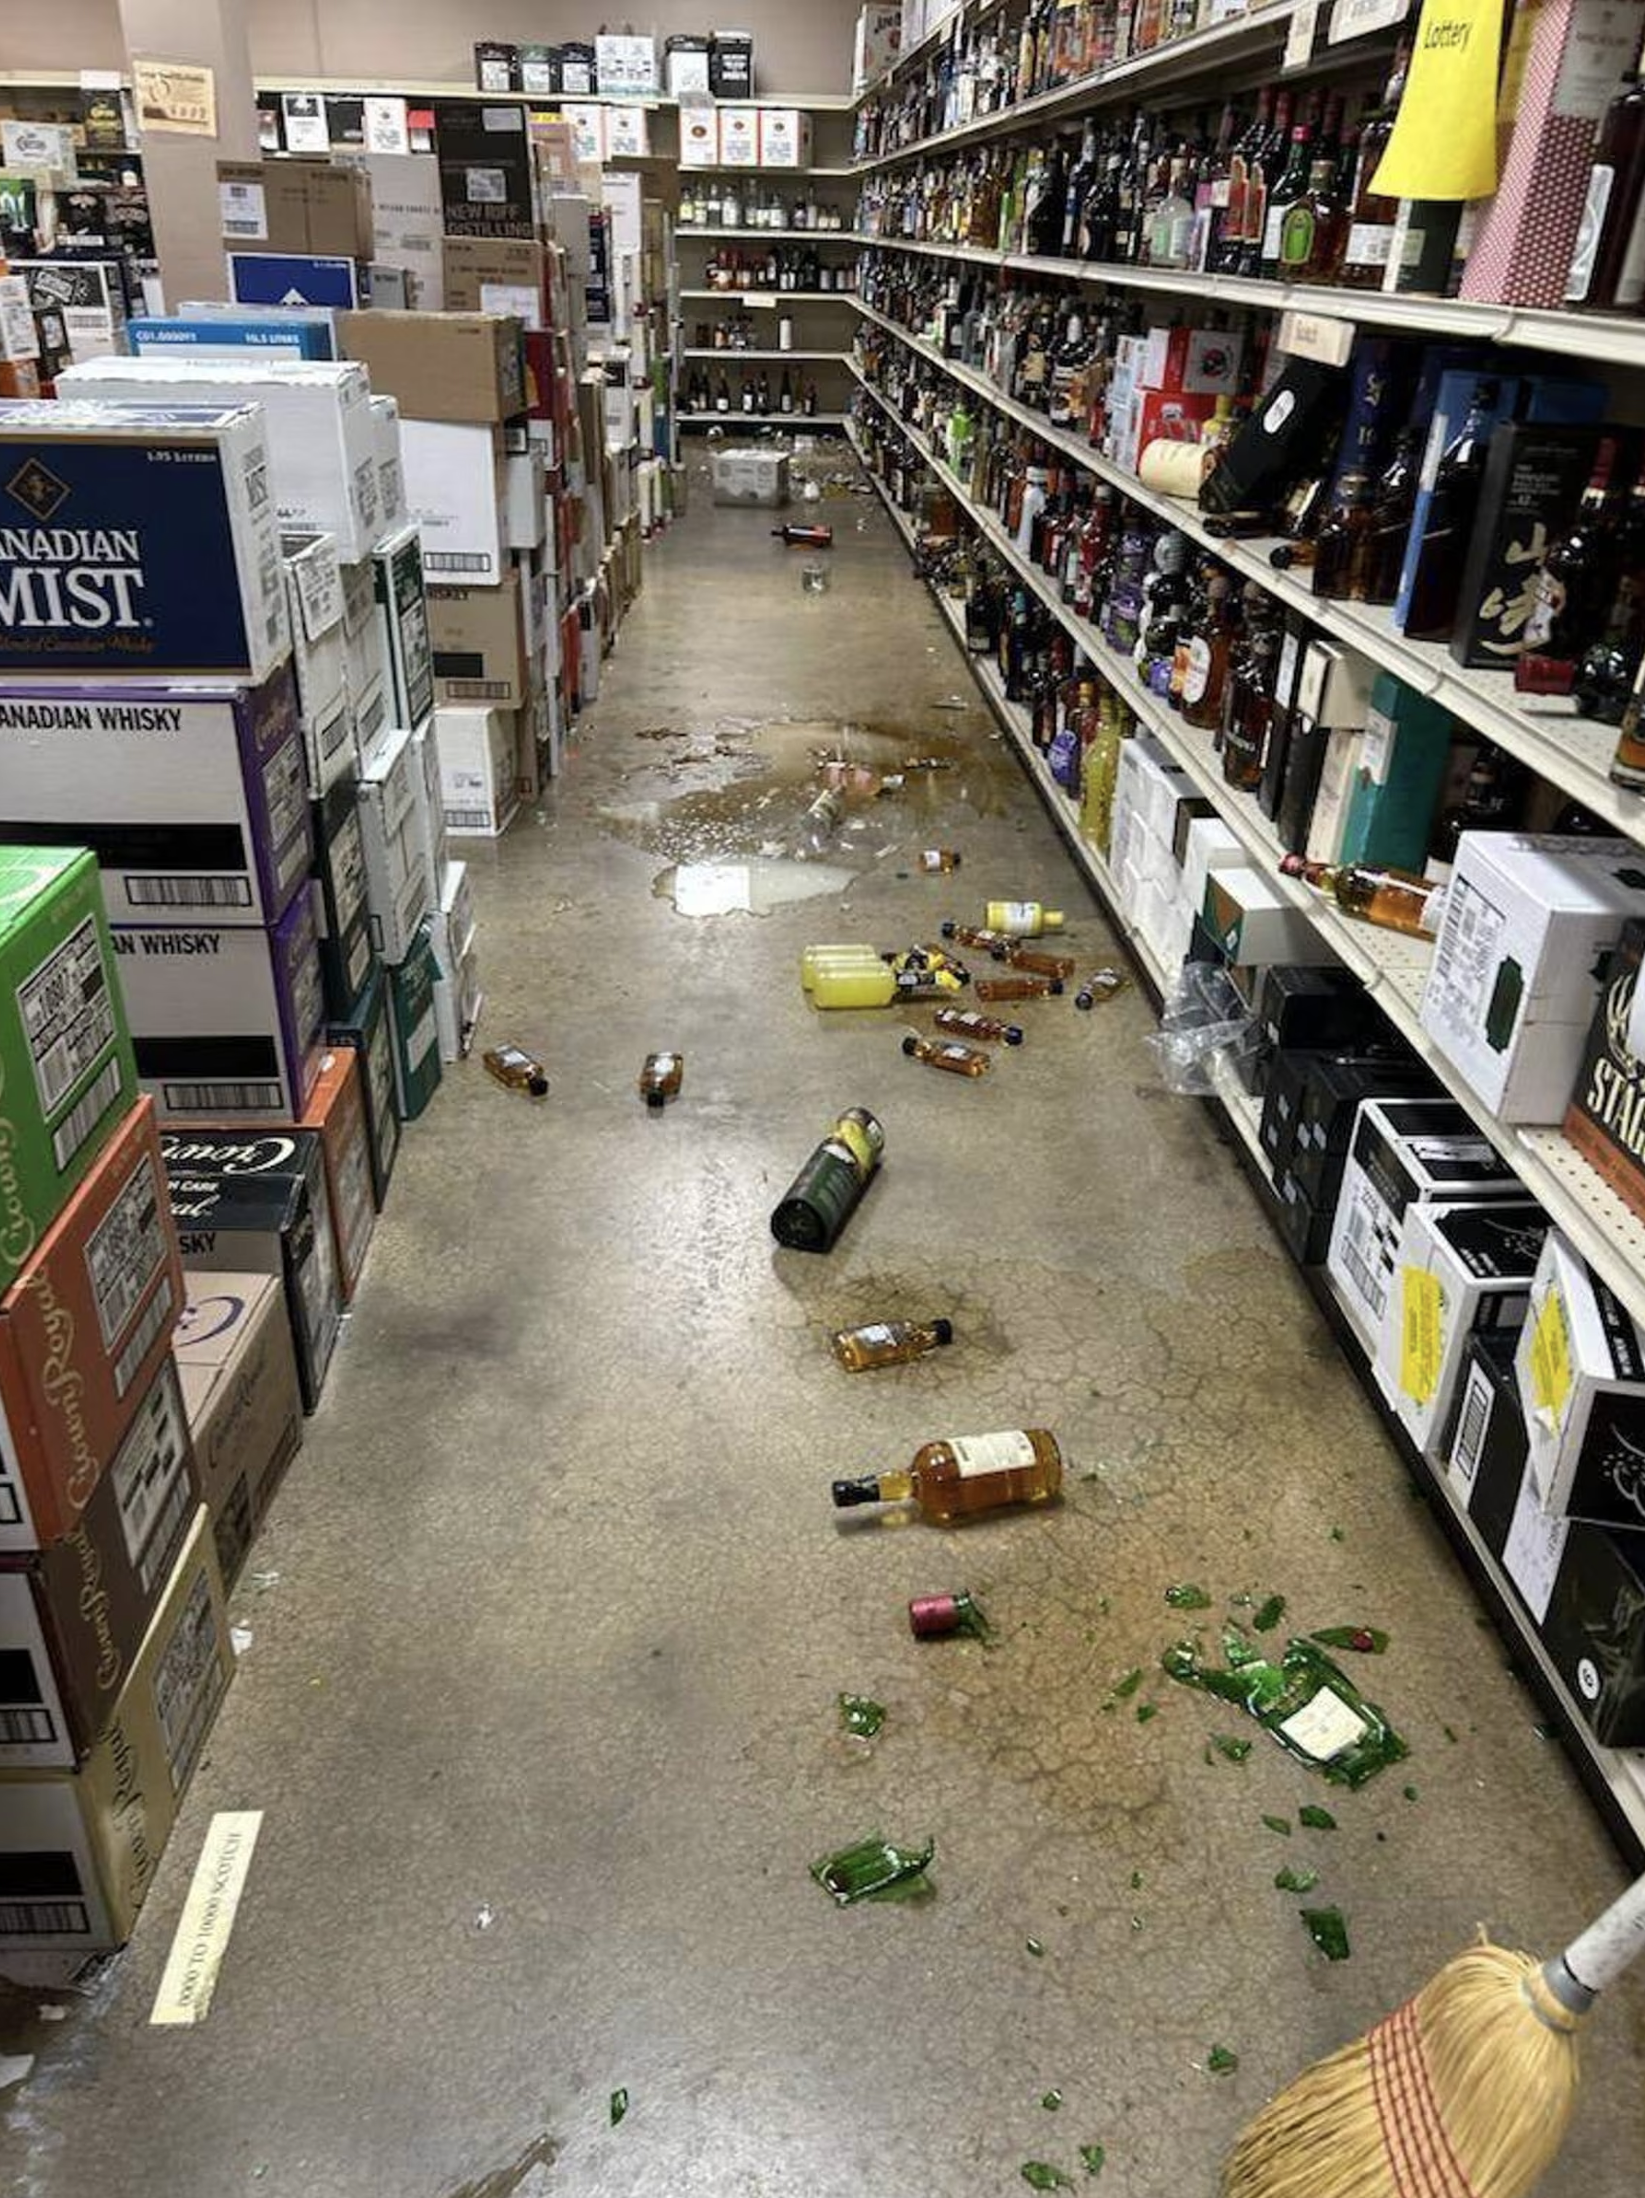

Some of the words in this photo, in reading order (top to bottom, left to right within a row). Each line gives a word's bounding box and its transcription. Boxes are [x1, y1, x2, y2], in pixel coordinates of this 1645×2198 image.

[0, 529, 139, 562] NADIAN
[0, 566, 145, 628] MIST
[97, 707, 181, 731] WHISKY
[140, 934, 220, 954] WHISKY
[1587, 1057, 1645, 1164] STAG
